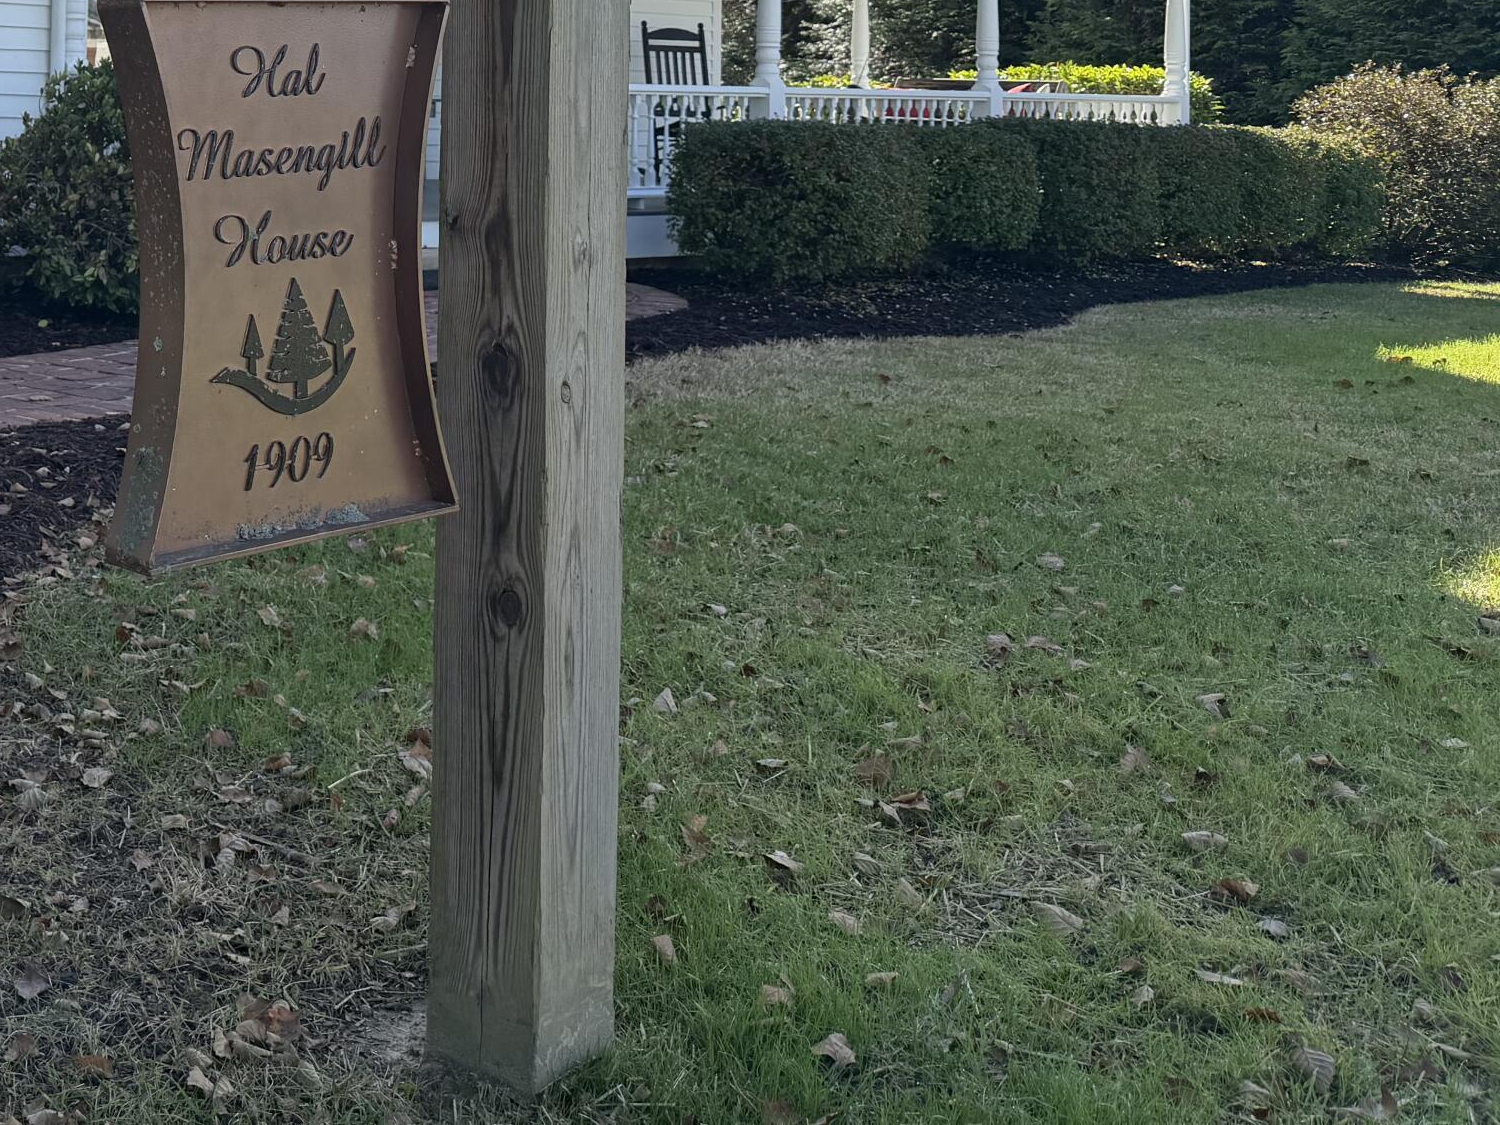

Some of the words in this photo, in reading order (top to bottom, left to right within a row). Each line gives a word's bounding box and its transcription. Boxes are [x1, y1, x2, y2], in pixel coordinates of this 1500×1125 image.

[230, 42, 325, 98] Hal
[178, 116, 386, 191] Masengill
[213, 210, 354, 267] House
[243, 431, 334, 491] 1909
